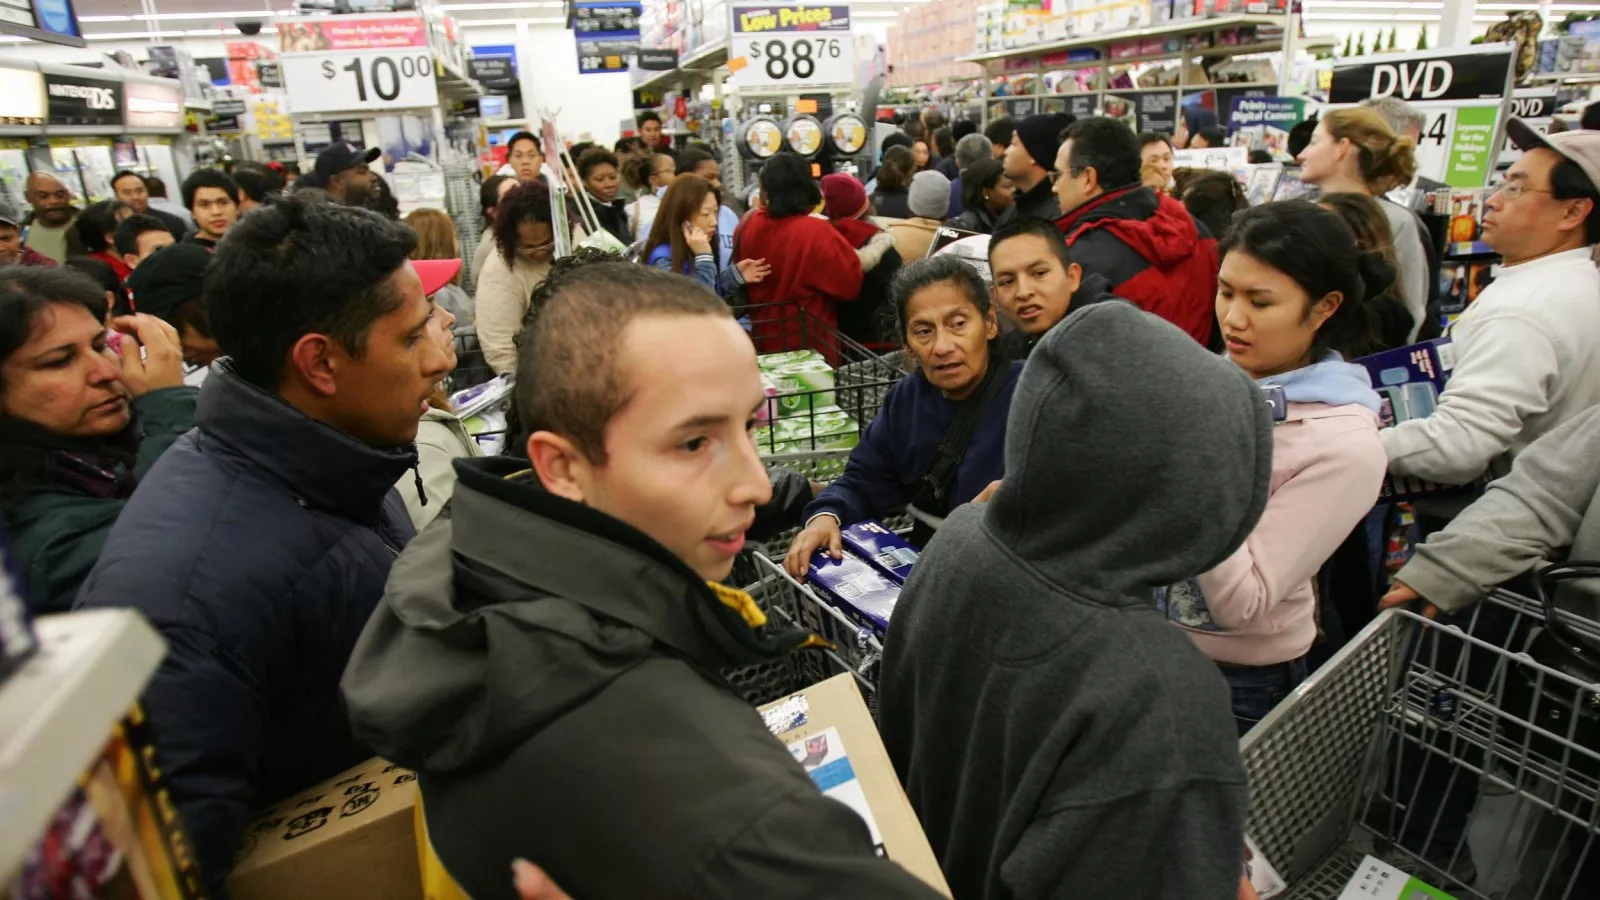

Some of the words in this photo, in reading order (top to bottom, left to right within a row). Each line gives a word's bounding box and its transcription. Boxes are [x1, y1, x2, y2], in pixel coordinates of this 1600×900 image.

[741, 13, 777, 32] Low
[778, 5, 832, 27] Prices
[1370, 60, 1453, 101] DVD
[1239, 100, 1267, 112] Prints
[1232, 111, 1263, 124] Digital
[1264, 111, 1297, 121] Camera
